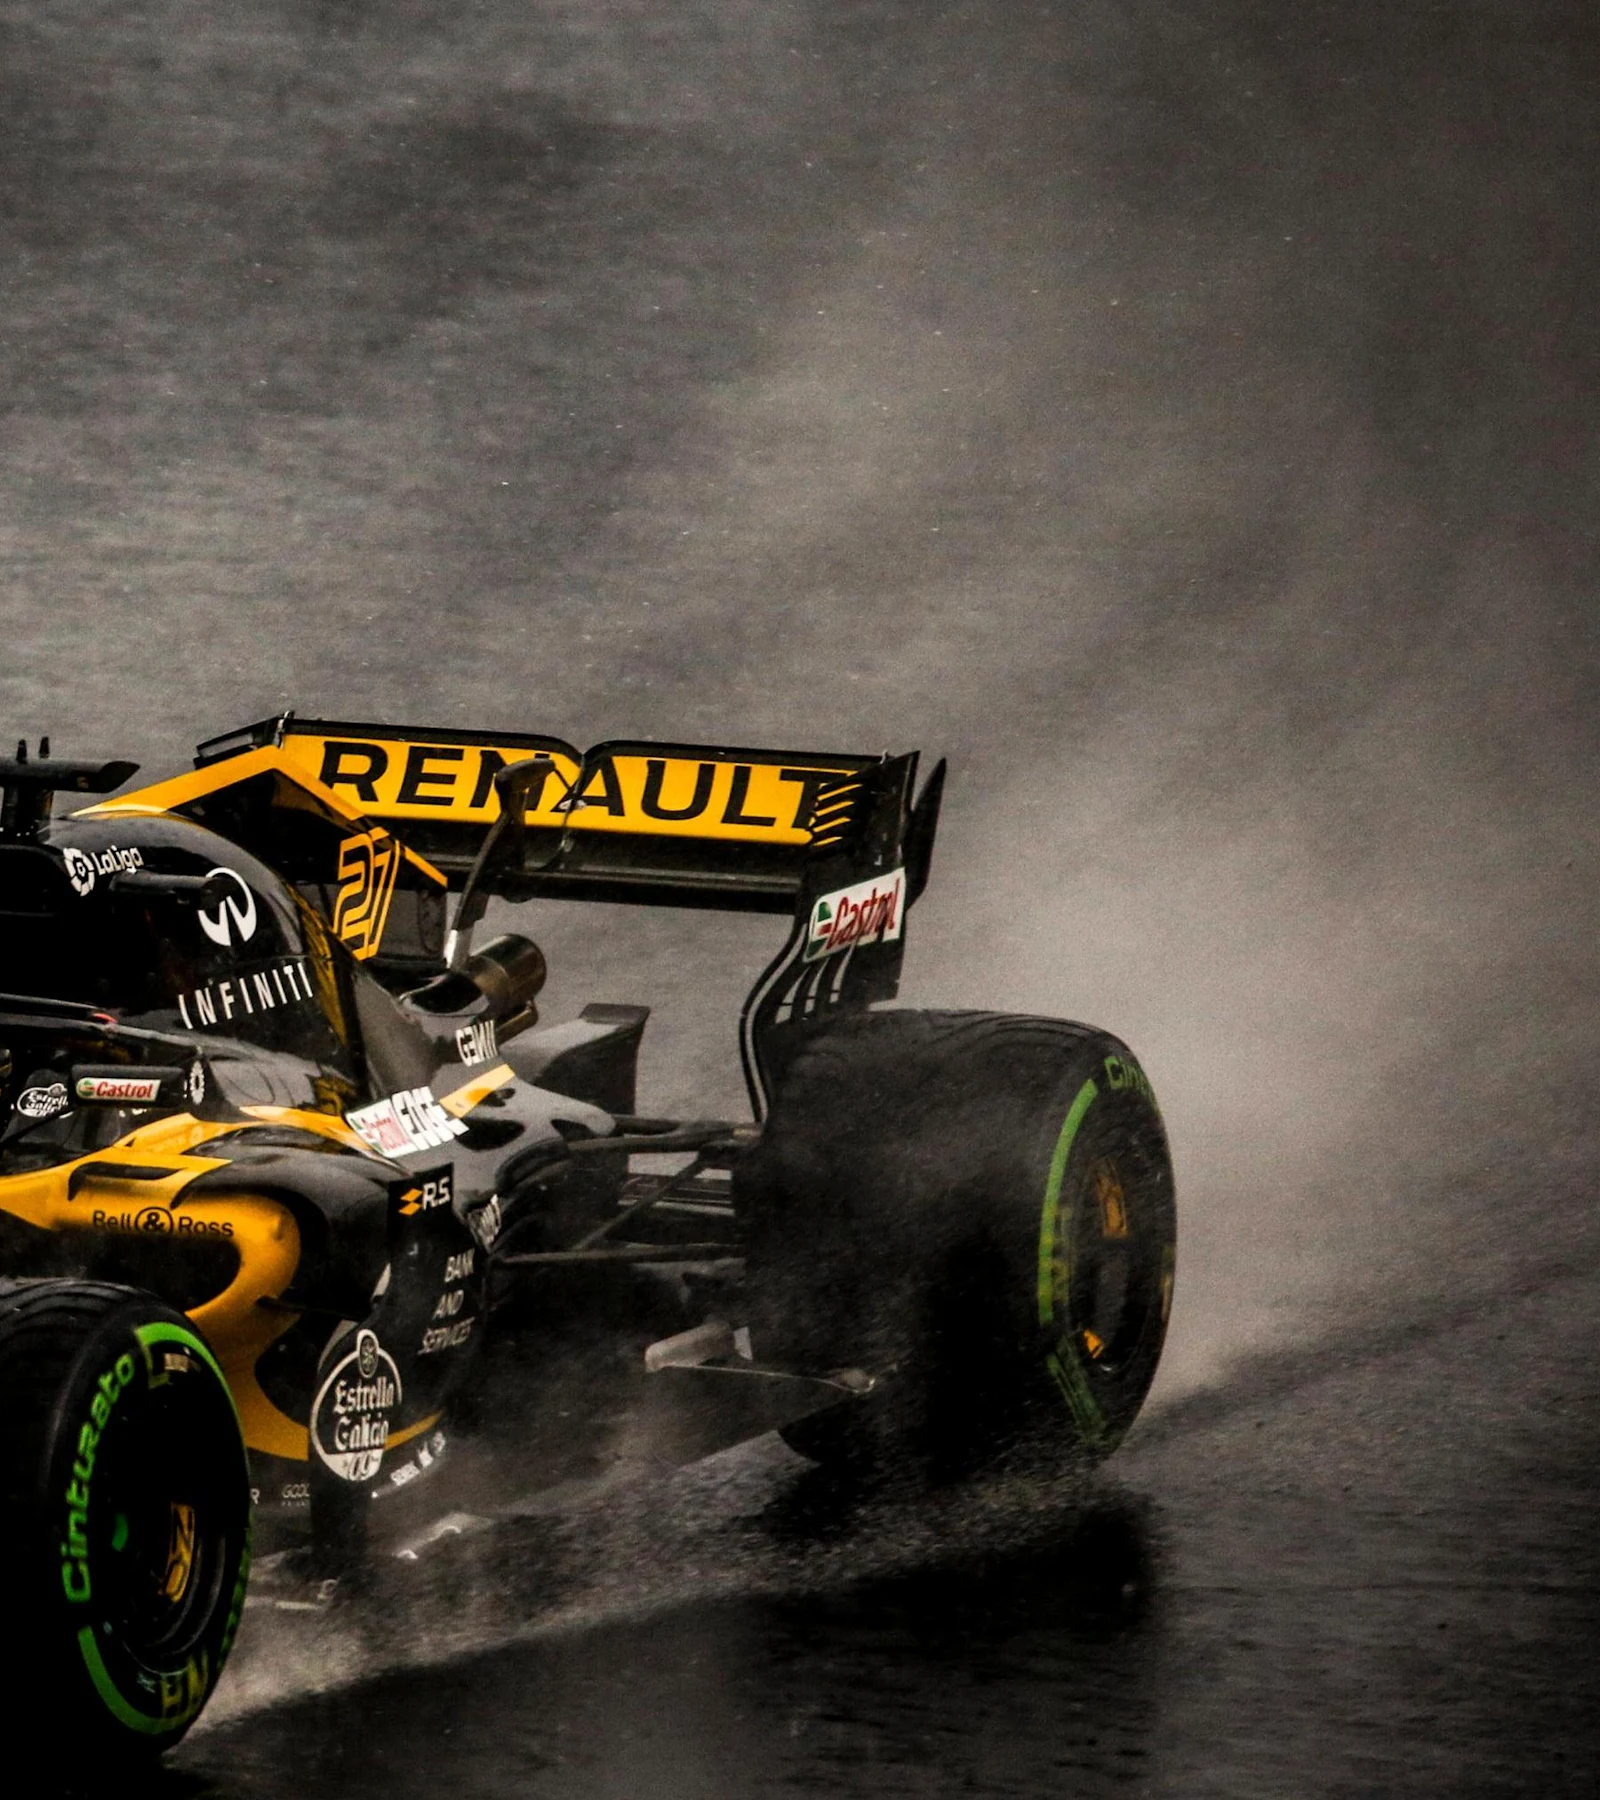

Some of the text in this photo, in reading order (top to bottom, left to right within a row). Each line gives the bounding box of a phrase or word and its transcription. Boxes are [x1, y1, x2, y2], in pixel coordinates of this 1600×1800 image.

[320, 741, 847, 828] RENAULT
[92, 845, 144, 875] LaLiga
[332, 826, 400, 960] 27
[826, 877, 900, 948] Castrol
[178, 962, 313, 1030] INFINITI
[96, 1081, 154, 1098] Castrol
[422, 1176, 450, 1211] RS
[93, 1210, 131, 1230] Bell
[179, 1216, 234, 1238] Ross
[332, 1375, 395, 1415] Estrella
[335, 1412, 390, 1451] Galicia
